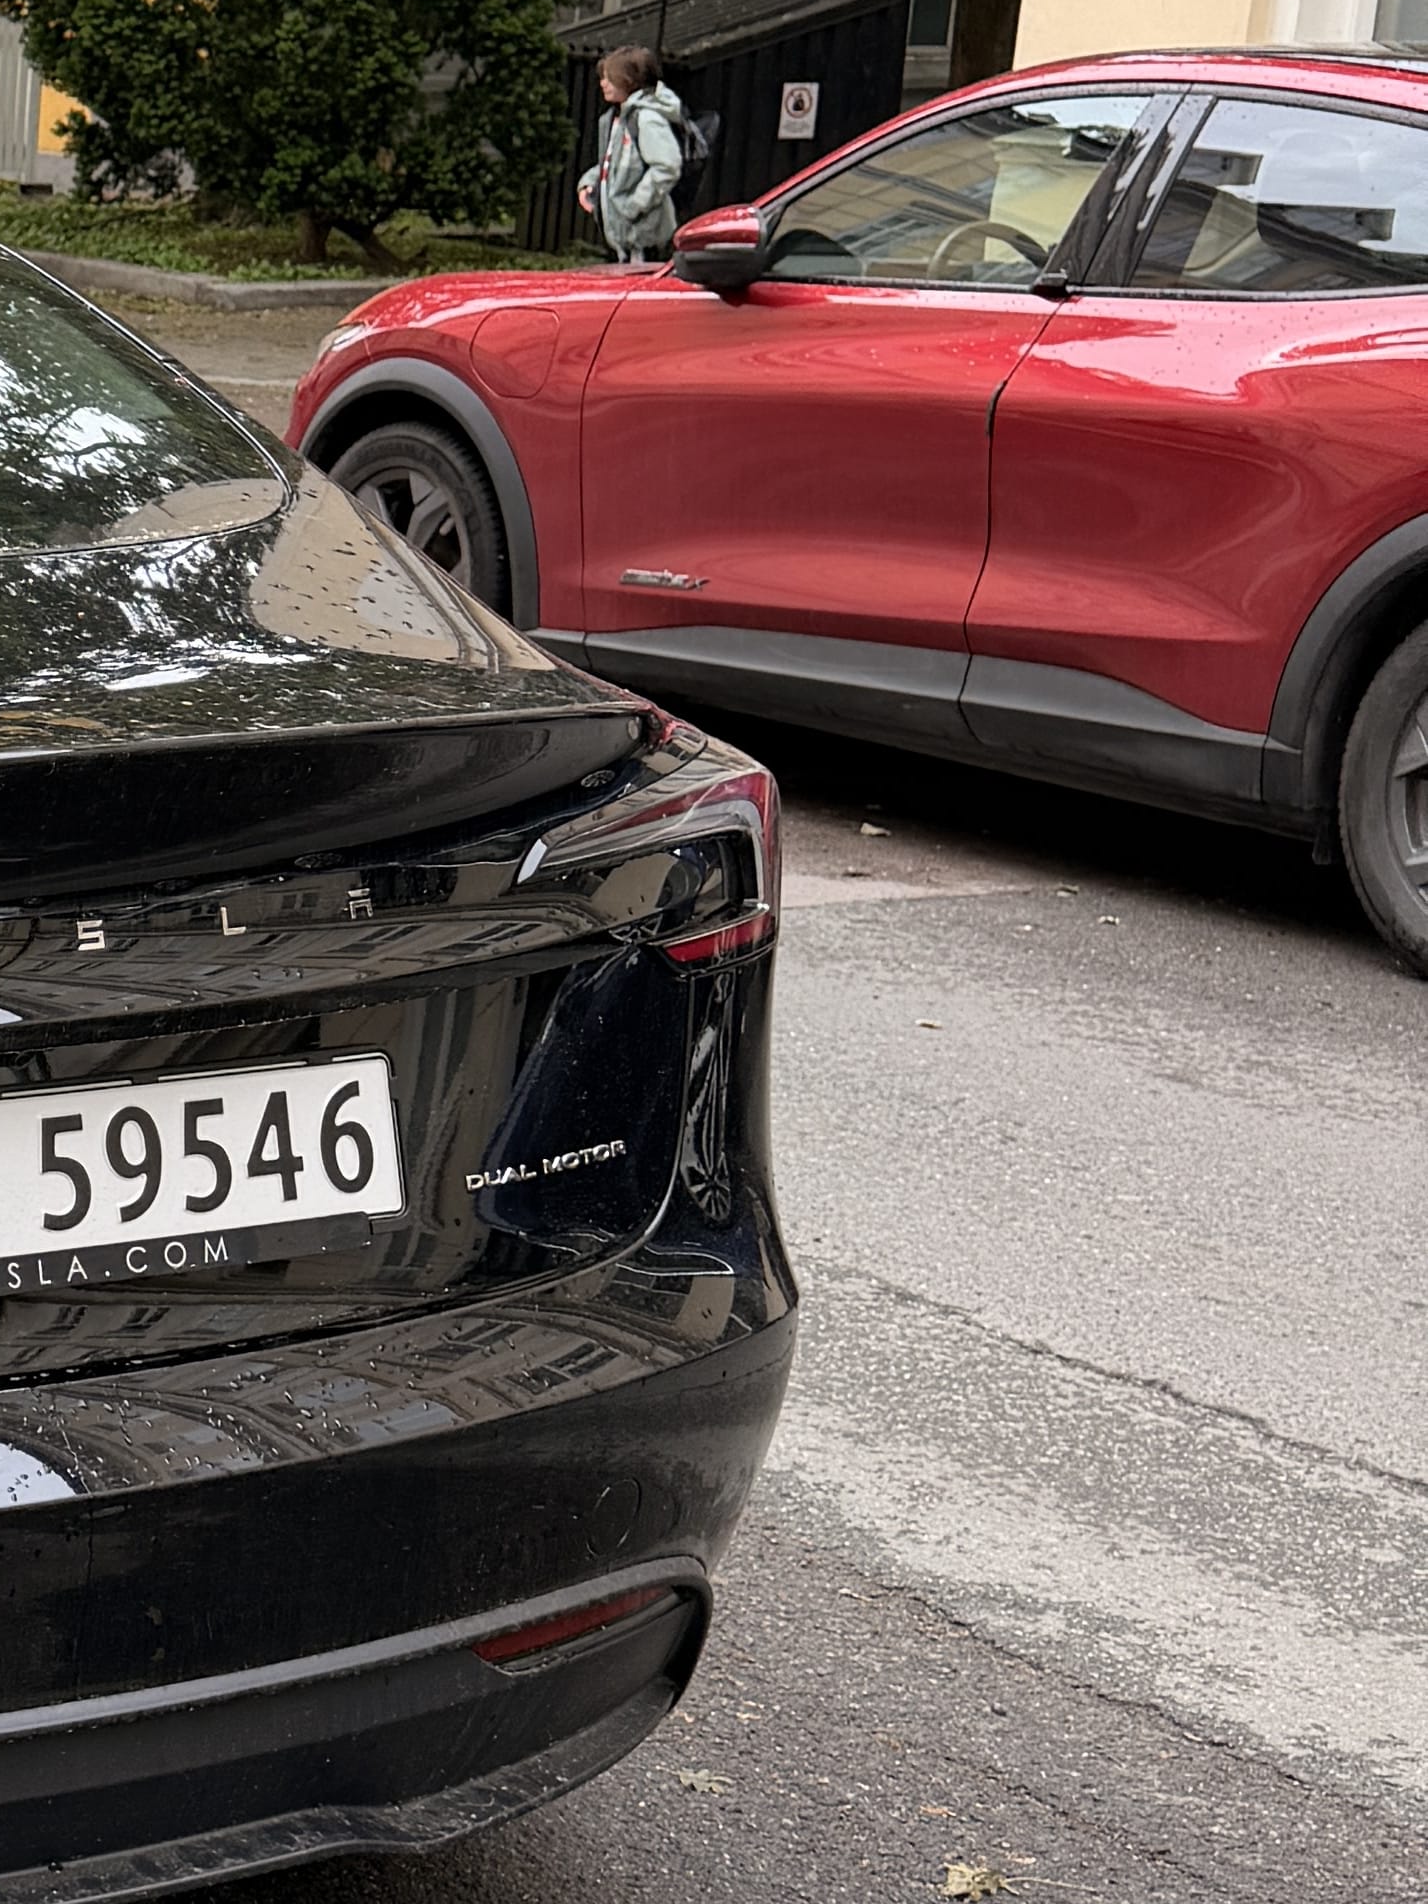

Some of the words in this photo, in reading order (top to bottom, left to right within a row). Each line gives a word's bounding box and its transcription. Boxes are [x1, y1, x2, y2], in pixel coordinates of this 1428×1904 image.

[39, 1080, 375, 1233] 59546
[465, 1164, 537, 1191] DUAL
[542, 1139, 627, 1175] MOTOR
